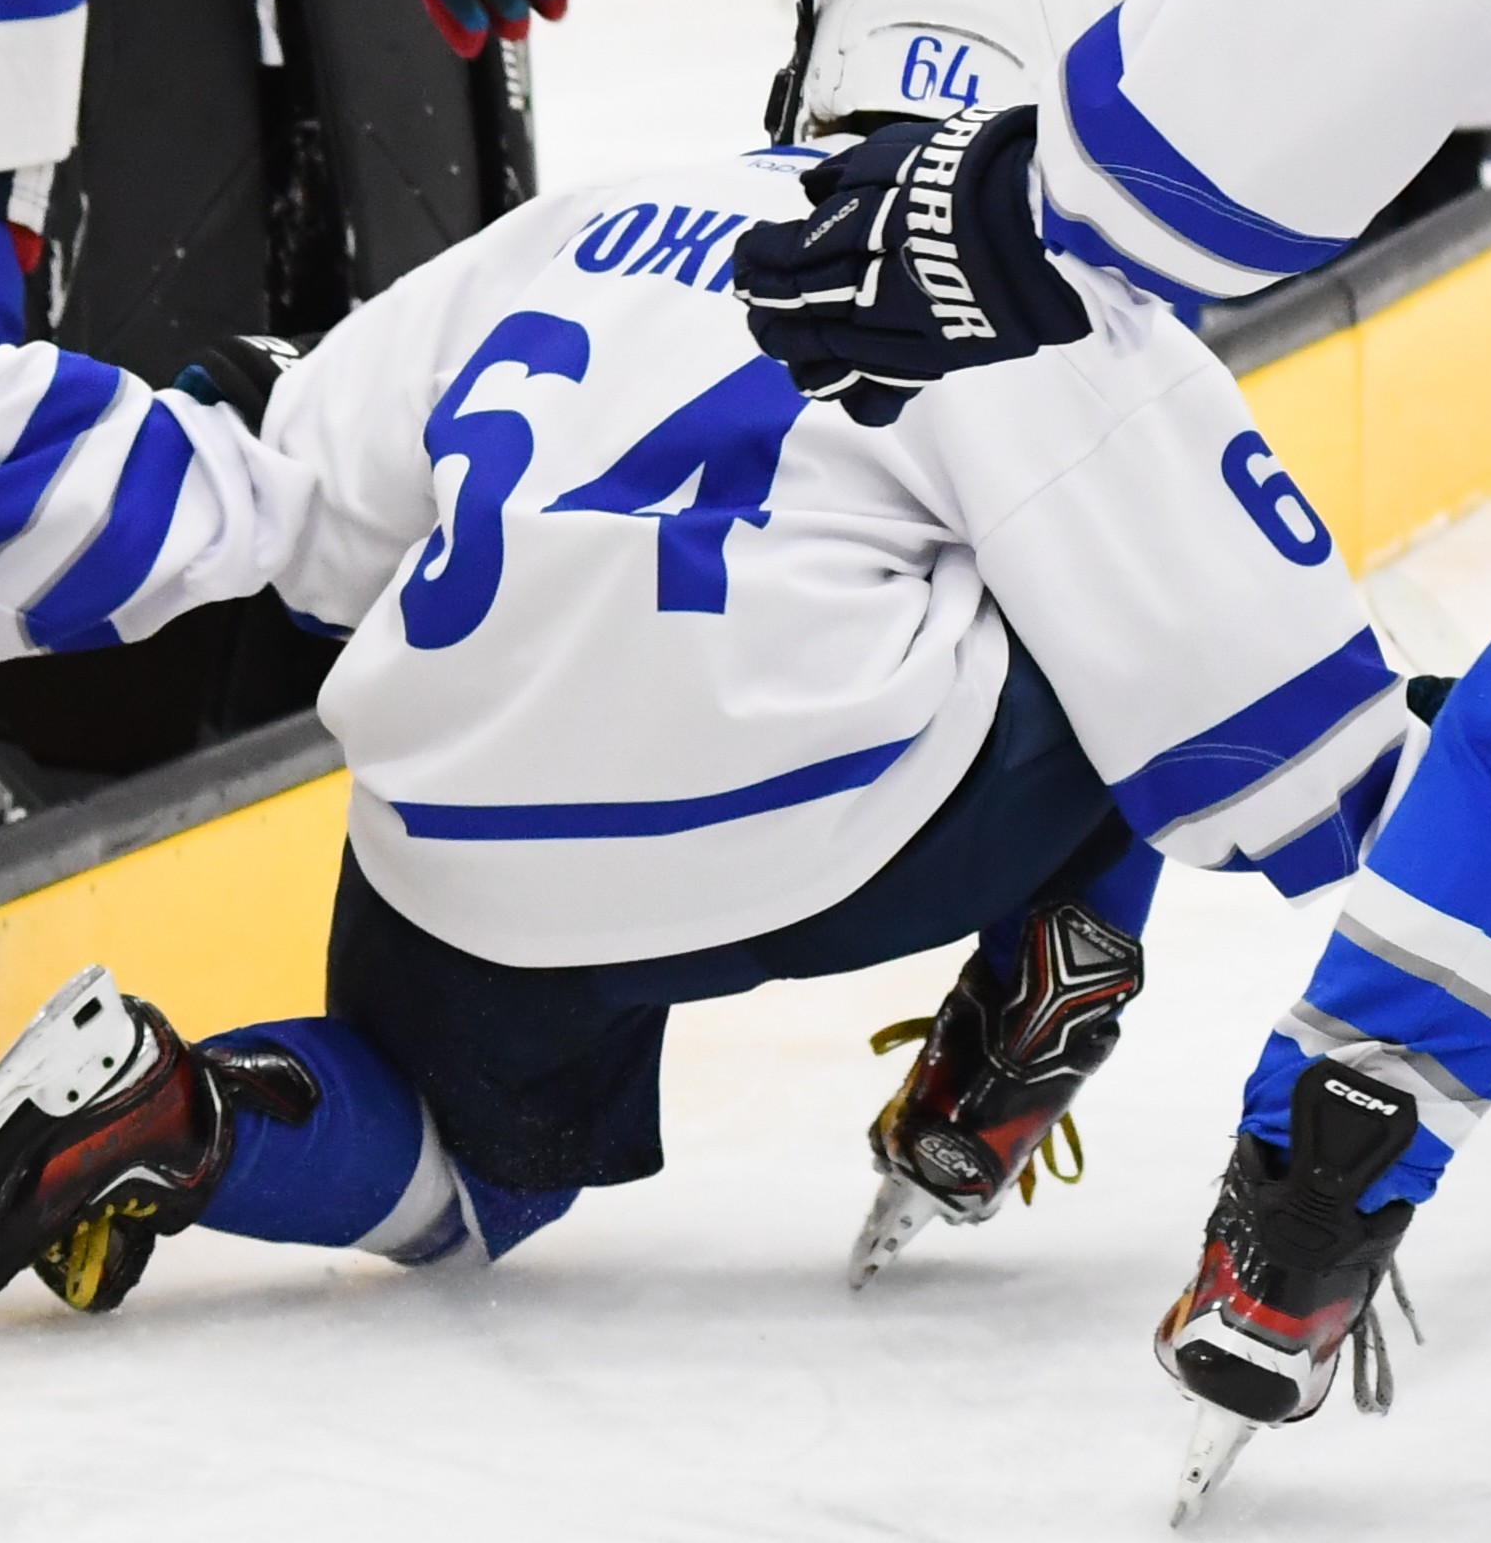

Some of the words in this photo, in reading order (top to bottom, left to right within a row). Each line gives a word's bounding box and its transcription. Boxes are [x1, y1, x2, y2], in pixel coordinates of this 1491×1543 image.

[901, 34, 980, 111] 64
[553, 202, 748, 294] ОЖ
[402, 310, 816, 652] 64
[1323, 1076, 1399, 1118] CCM
